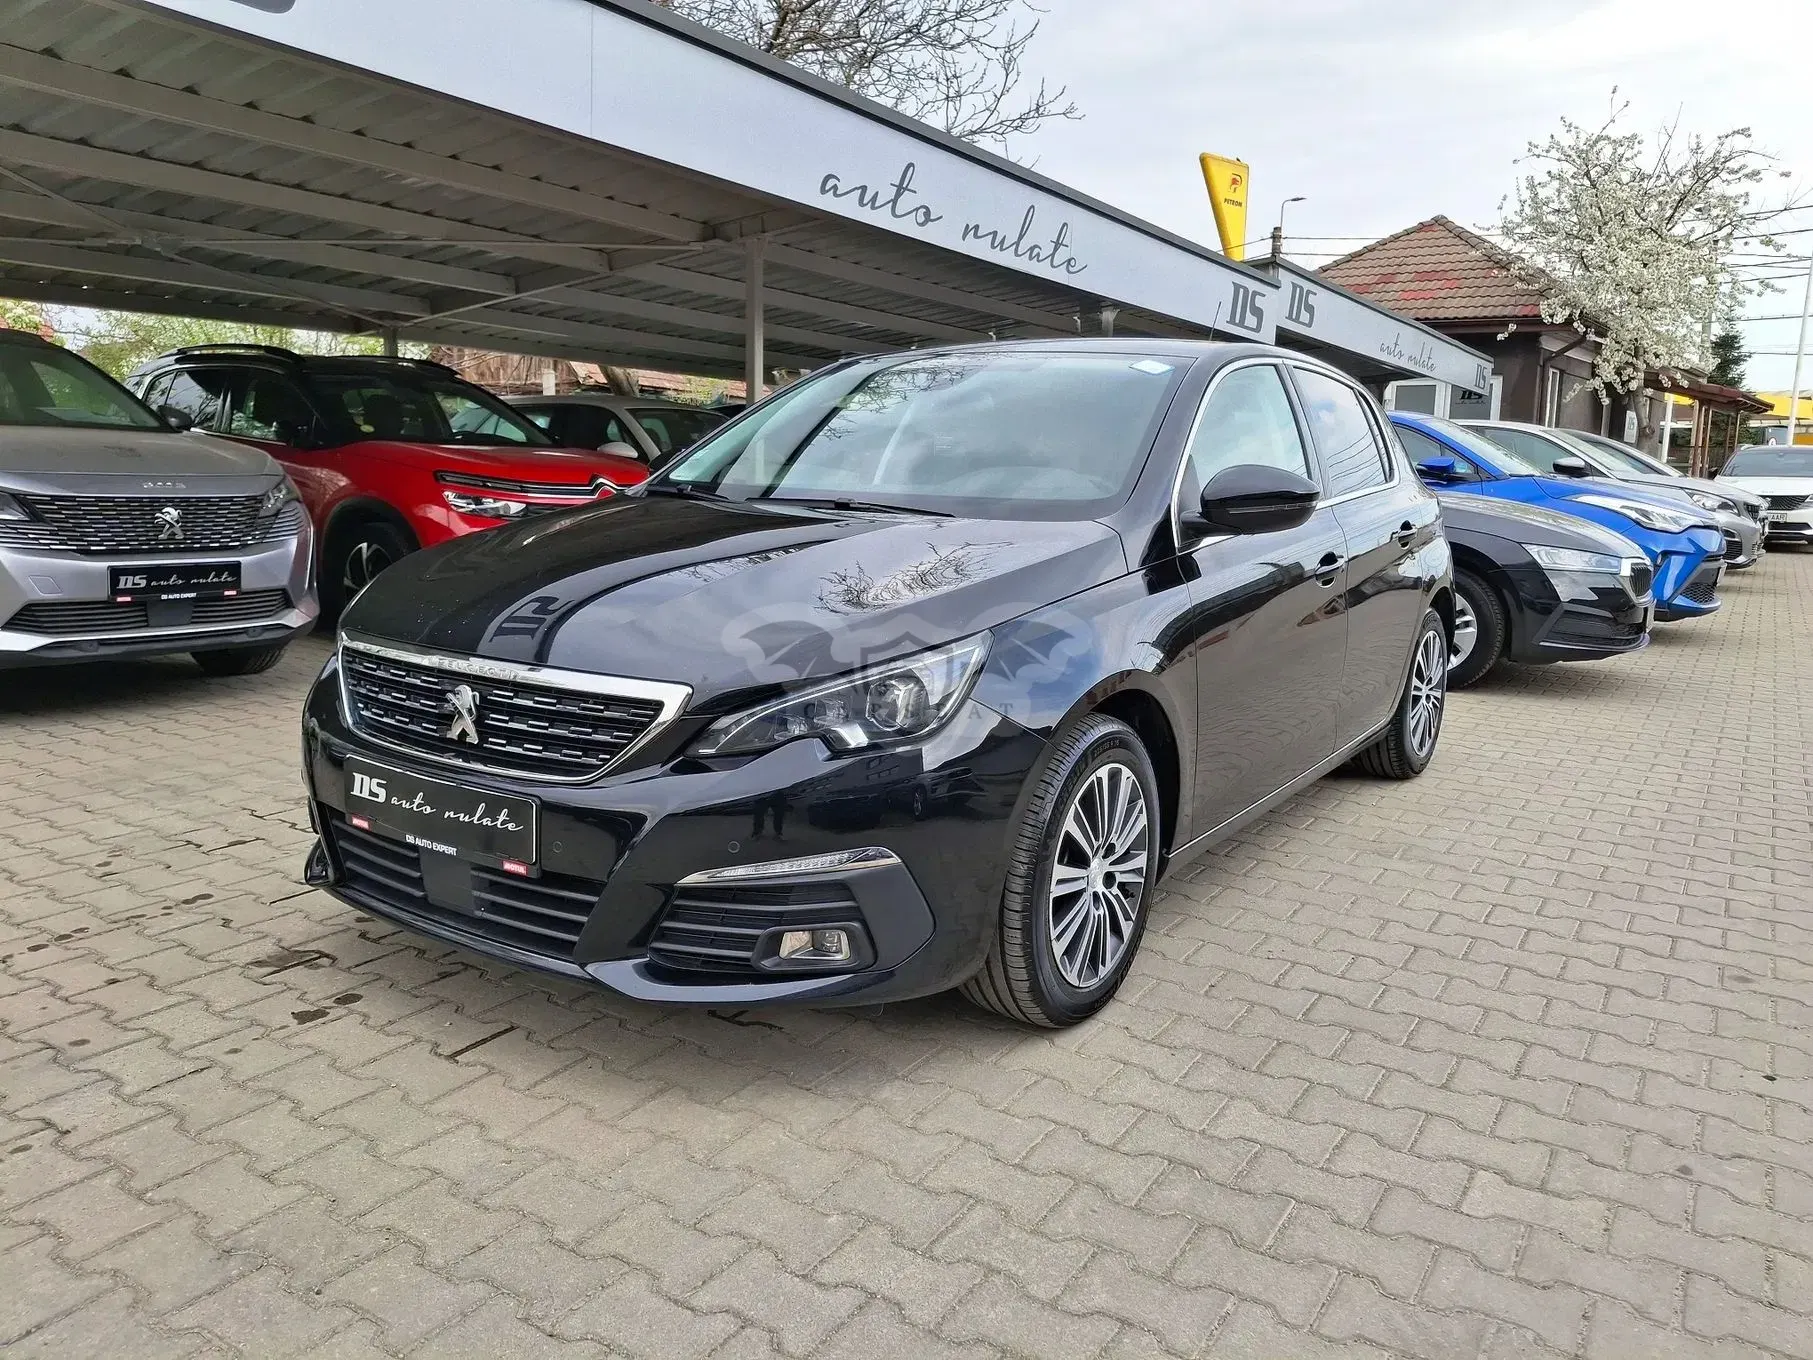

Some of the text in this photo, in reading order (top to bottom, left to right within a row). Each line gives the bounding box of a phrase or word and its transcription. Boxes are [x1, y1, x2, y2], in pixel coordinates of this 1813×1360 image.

[1223, 198, 1243, 208] PETROM
[820, 162, 1088, 275] auto rulate
[1226, 281, 1266, 333] DS
[1285, 281, 1317, 328] DS
[1380, 332, 1404, 359] auto
[1474, 363, 1487, 390] DS
[116, 575, 147, 588] DS
[151, 574, 185, 586] auto
[351, 772, 387, 803] DS
[391, 791, 436, 814] auto
[405, 834, 457, 855] DS AUTO EXPERT
